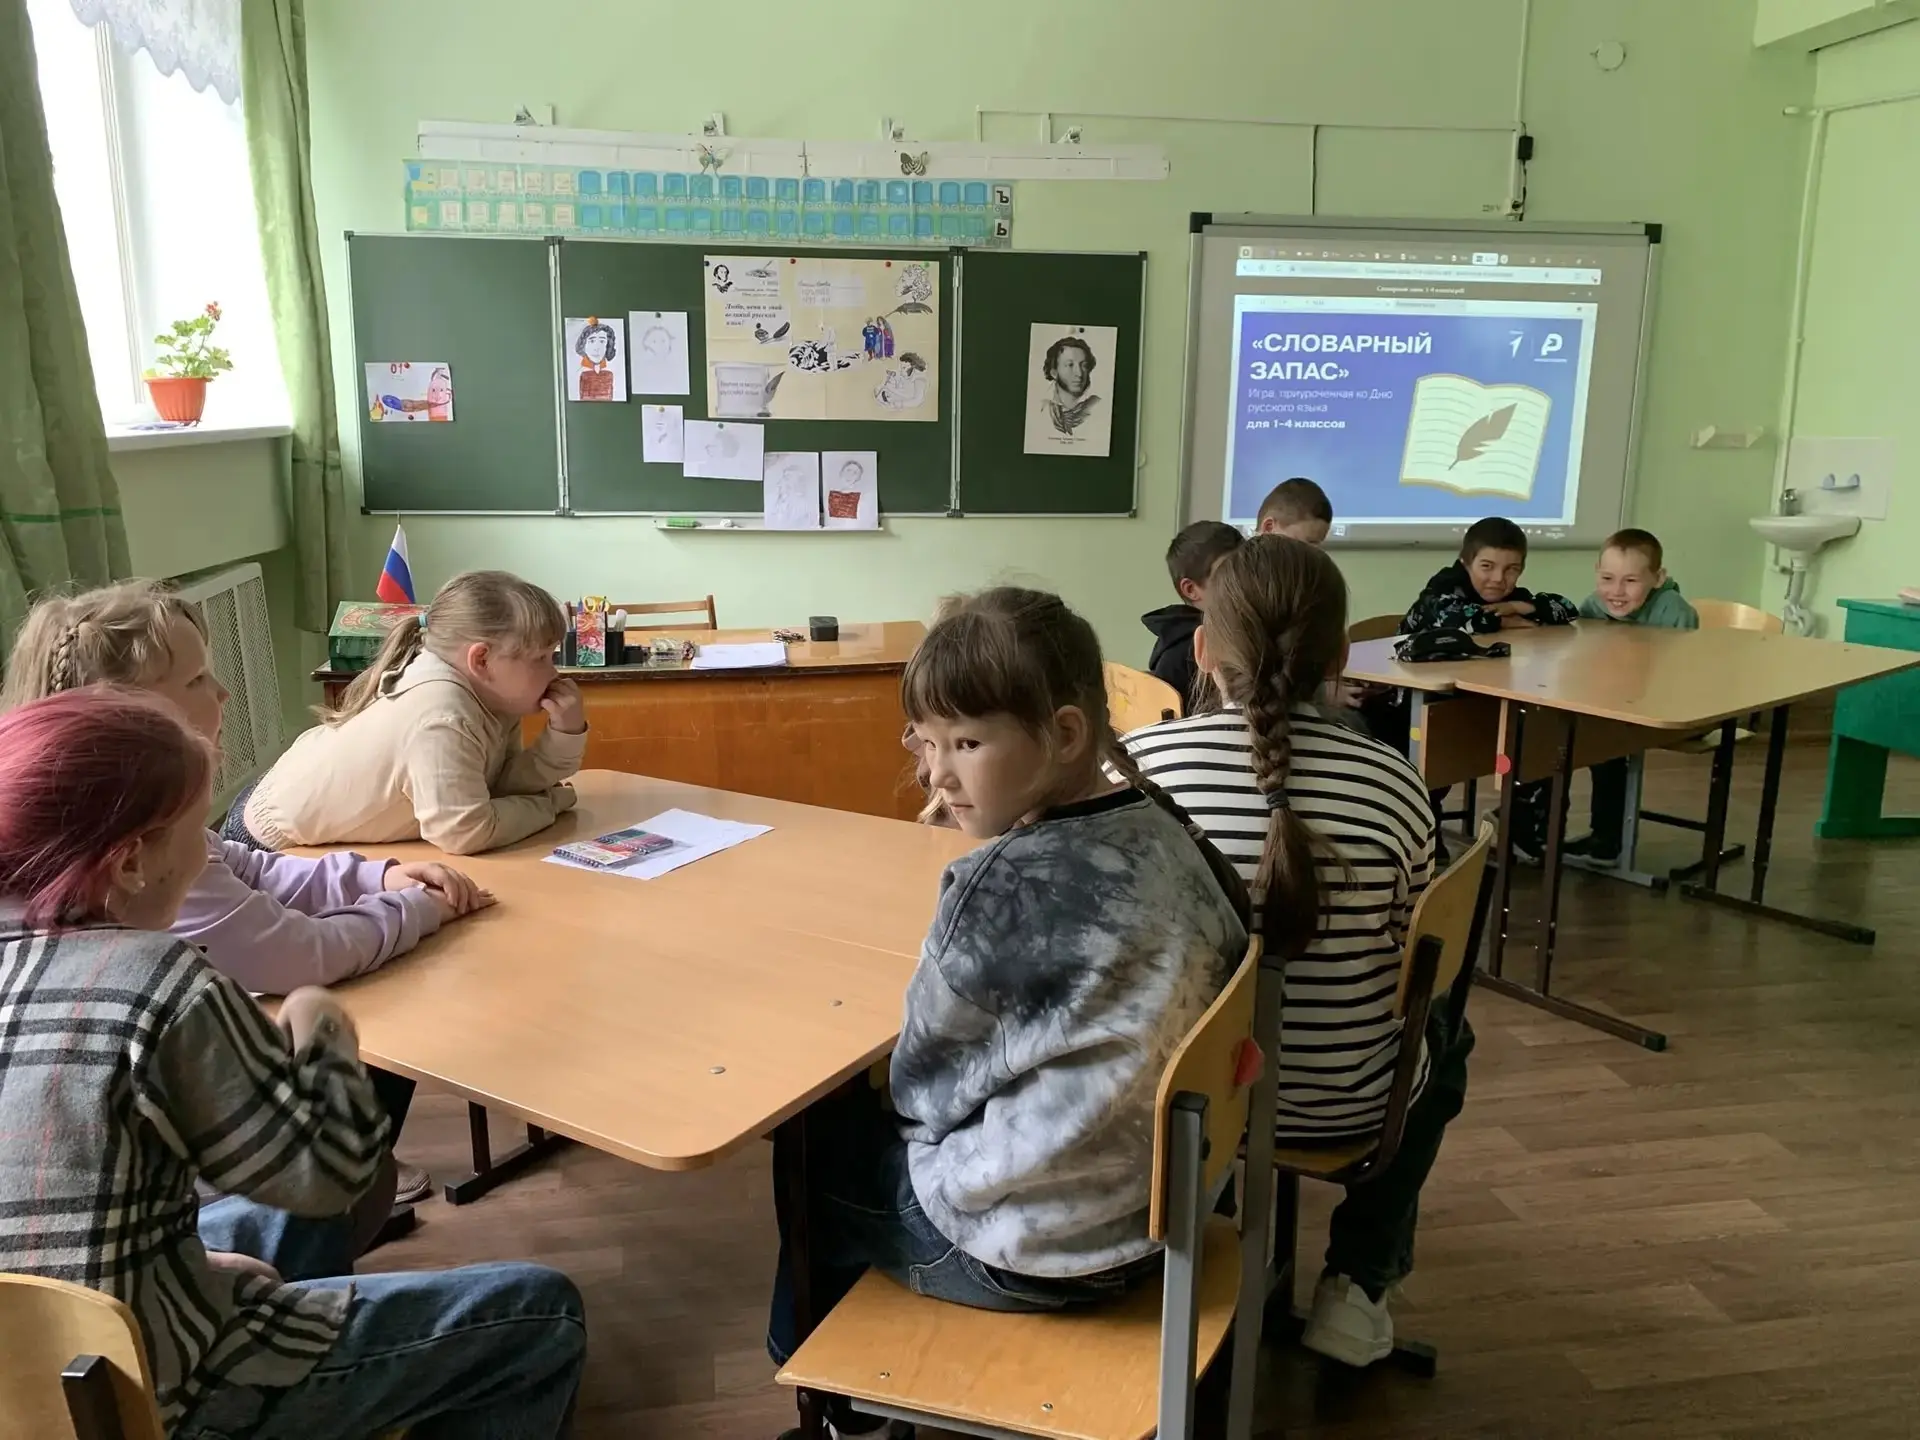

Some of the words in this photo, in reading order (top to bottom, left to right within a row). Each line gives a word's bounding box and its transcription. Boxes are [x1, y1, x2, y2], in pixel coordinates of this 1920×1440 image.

[1252, 331, 1432, 354] «СЛОВАРНЫЙ
[1250, 361, 1350, 381] ЗАПАС»
[1280, 389, 1354, 400] приуроченная
[1356, 391, 1368, 399] ко
[1369, 388, 1394, 401] Дню
[1247, 403, 1295, 414] русского
[1296, 404, 1328, 413] языка
[1246, 420, 1270, 430] для
[1294, 420, 1346, 429] классов
